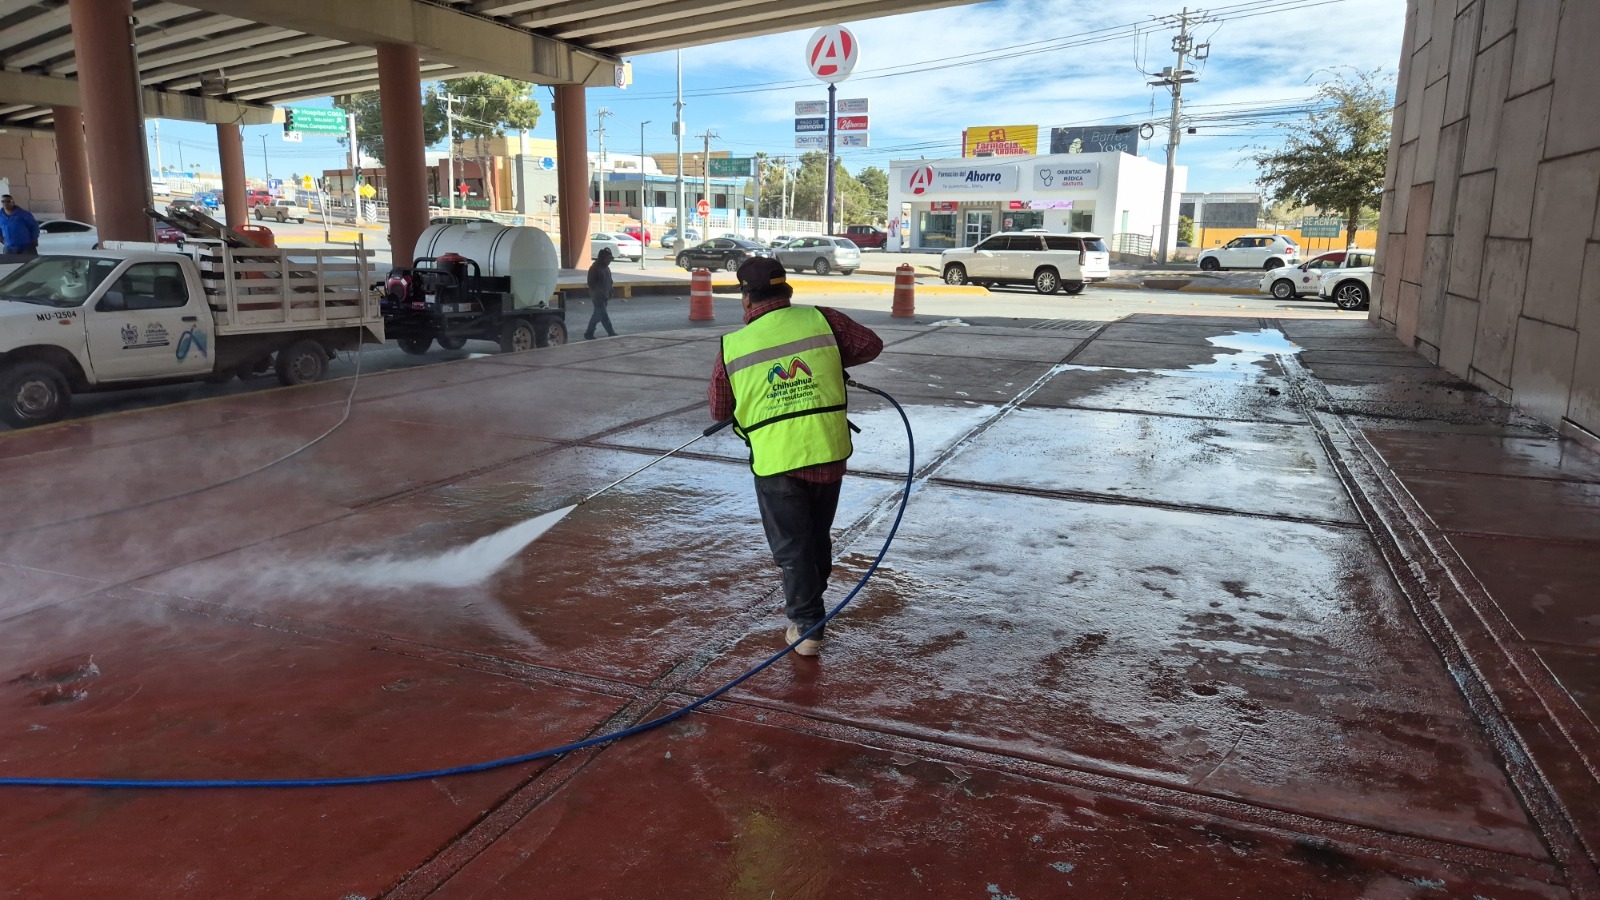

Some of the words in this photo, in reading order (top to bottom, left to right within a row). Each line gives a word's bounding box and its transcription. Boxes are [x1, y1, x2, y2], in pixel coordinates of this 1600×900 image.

[301, 109, 326, 117] Hospital
[797, 135, 824, 144] derma
[1099, 142, 1128, 152] Yoga
[965, 170, 1002, 182] Ahorro
[1303, 217, 1313, 226] SE
[1314, 217, 1338, 226] RENTA
[37, 310, 77, 322] MU-12504
[773, 377, 812, 391] Chihuahua
[766, 389, 788, 399] capital
[797, 383, 819, 392] trabajo
[782, 390, 813, 401] resultados
